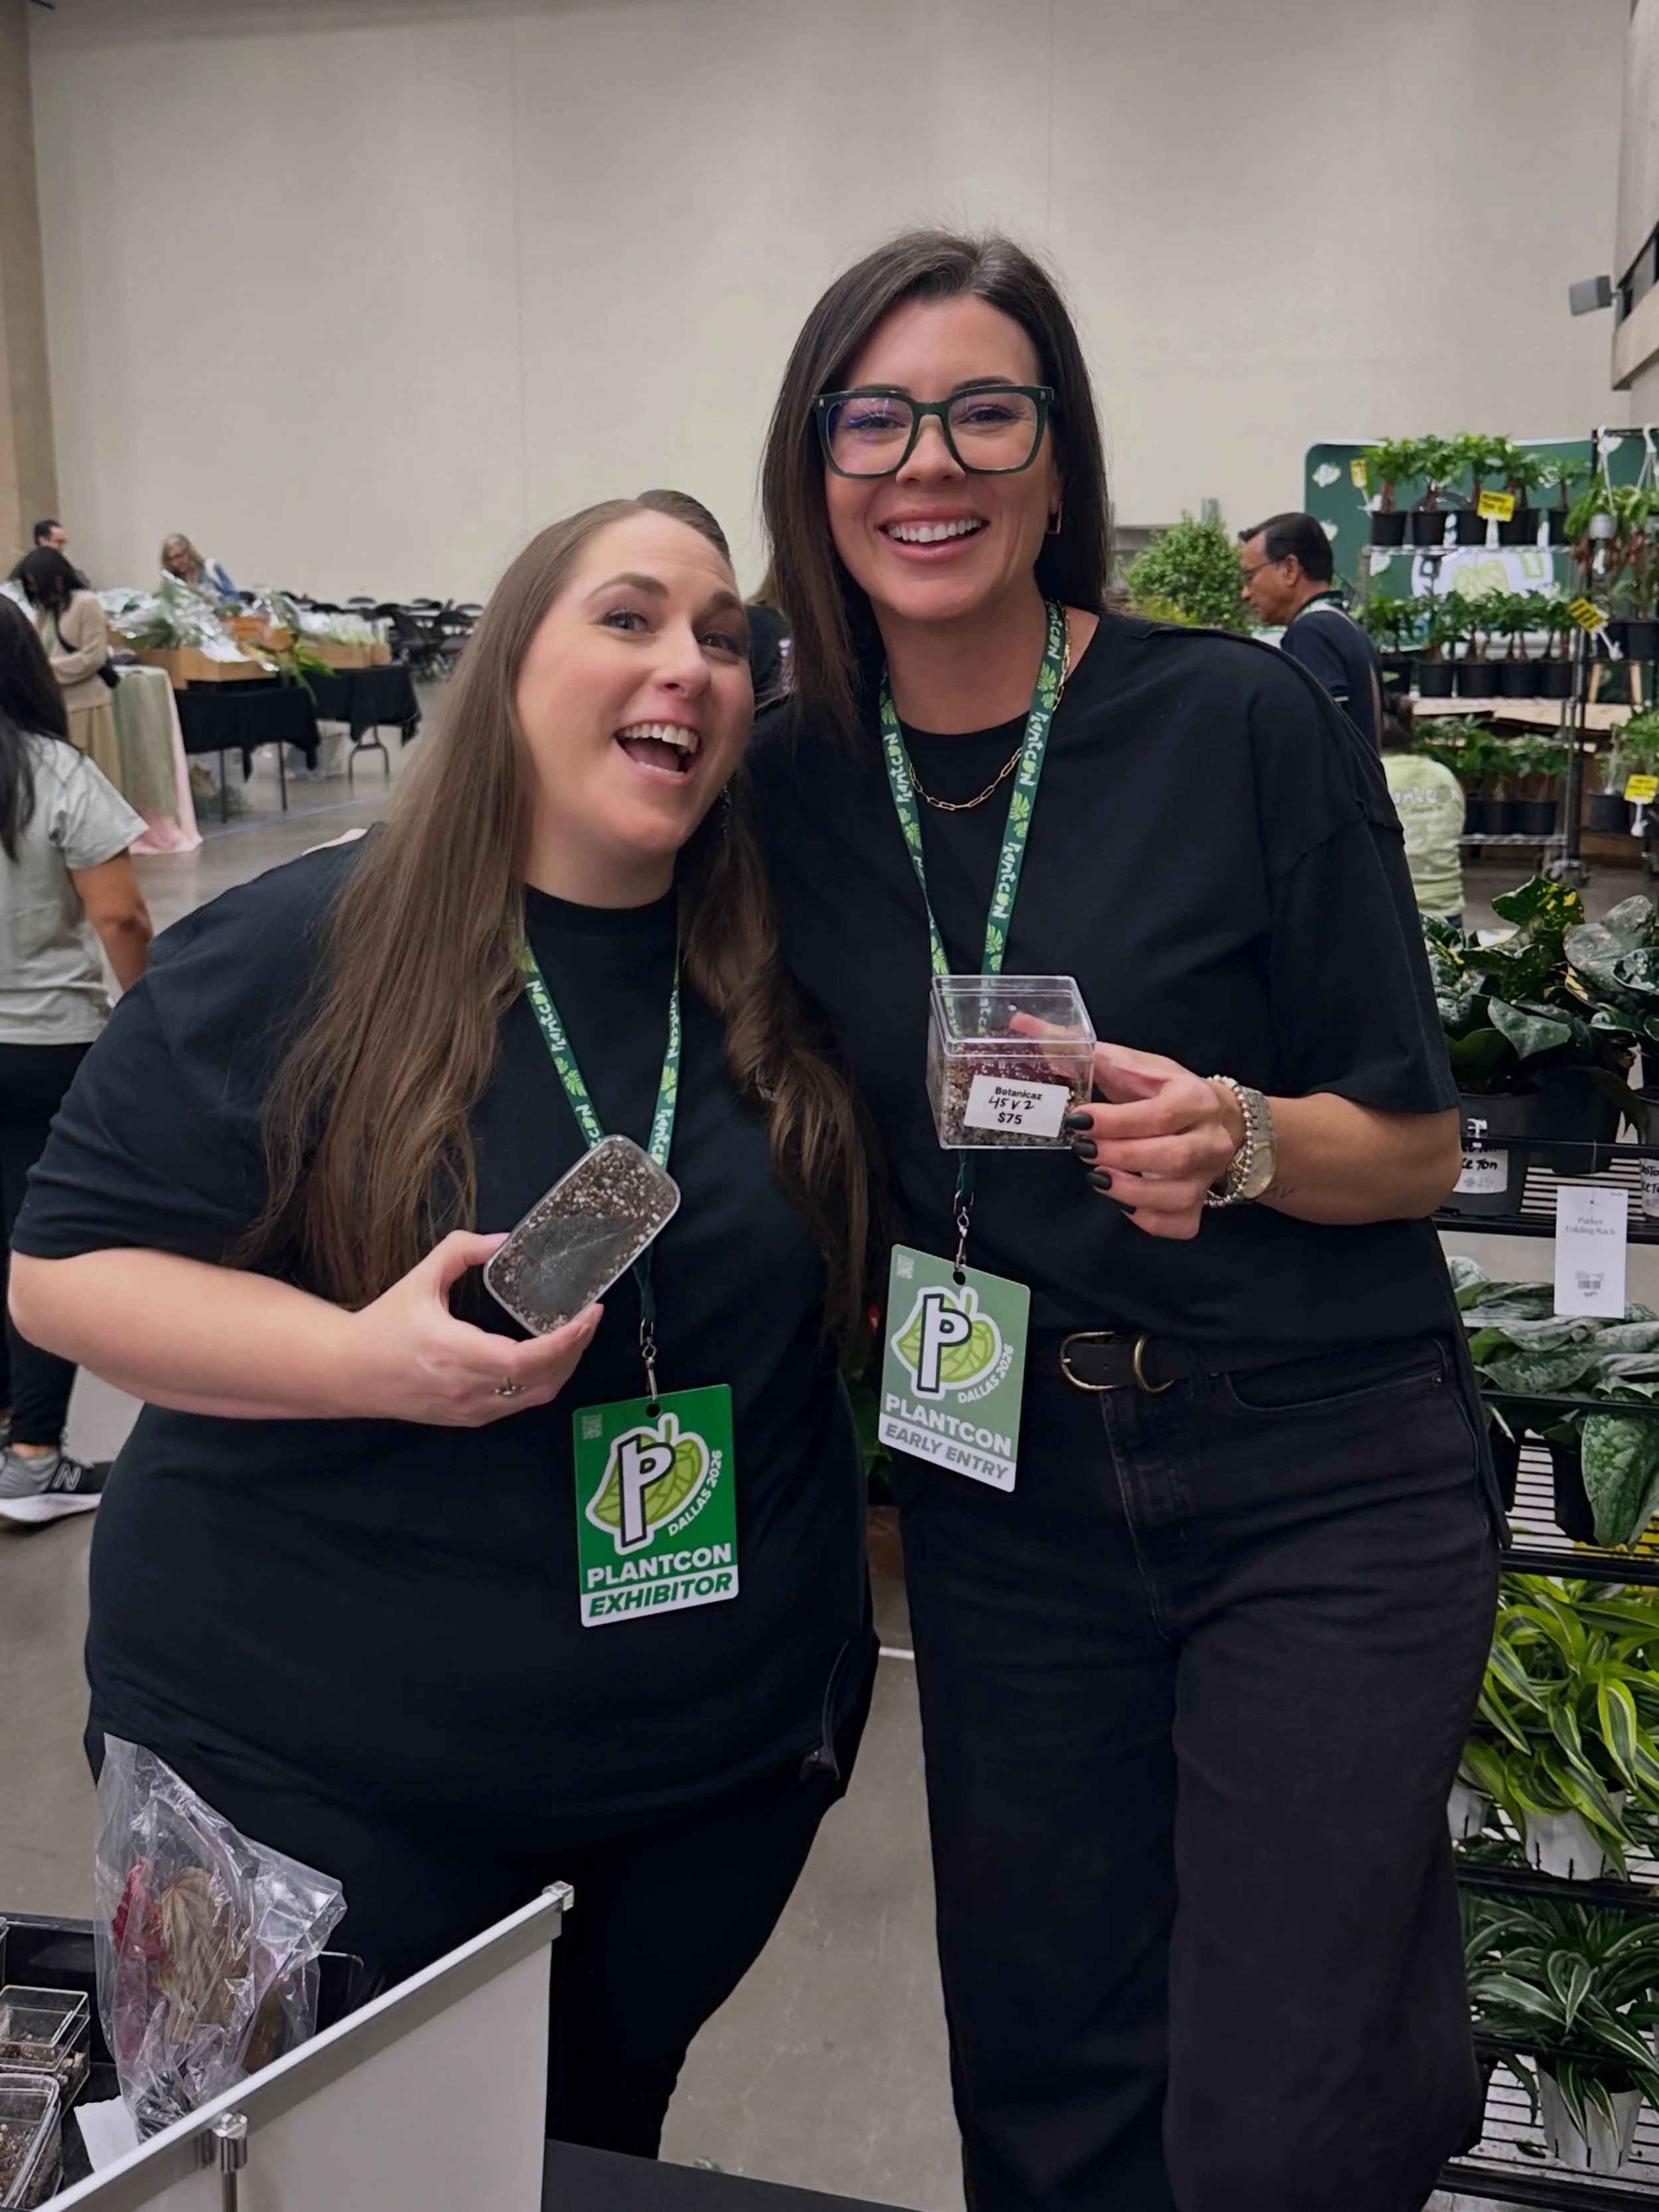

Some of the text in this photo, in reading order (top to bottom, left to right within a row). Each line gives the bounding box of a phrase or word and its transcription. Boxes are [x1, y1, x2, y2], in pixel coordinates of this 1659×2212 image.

[995, 1086, 1043, 1100] Botanicaz
[997, 1111, 1023, 1125] $75
[958, 1344, 1013, 1404] DALLAS 2026
[885, 1393, 1012, 1457] PLANTCON
[885, 1423, 1009, 1480] EARLY ENTRY
[668, 1449, 723, 1536] DALLAS 2026
[587, 1543, 731, 1589] PLANTCON
[589, 1572, 733, 1617] EXHIBITOR
